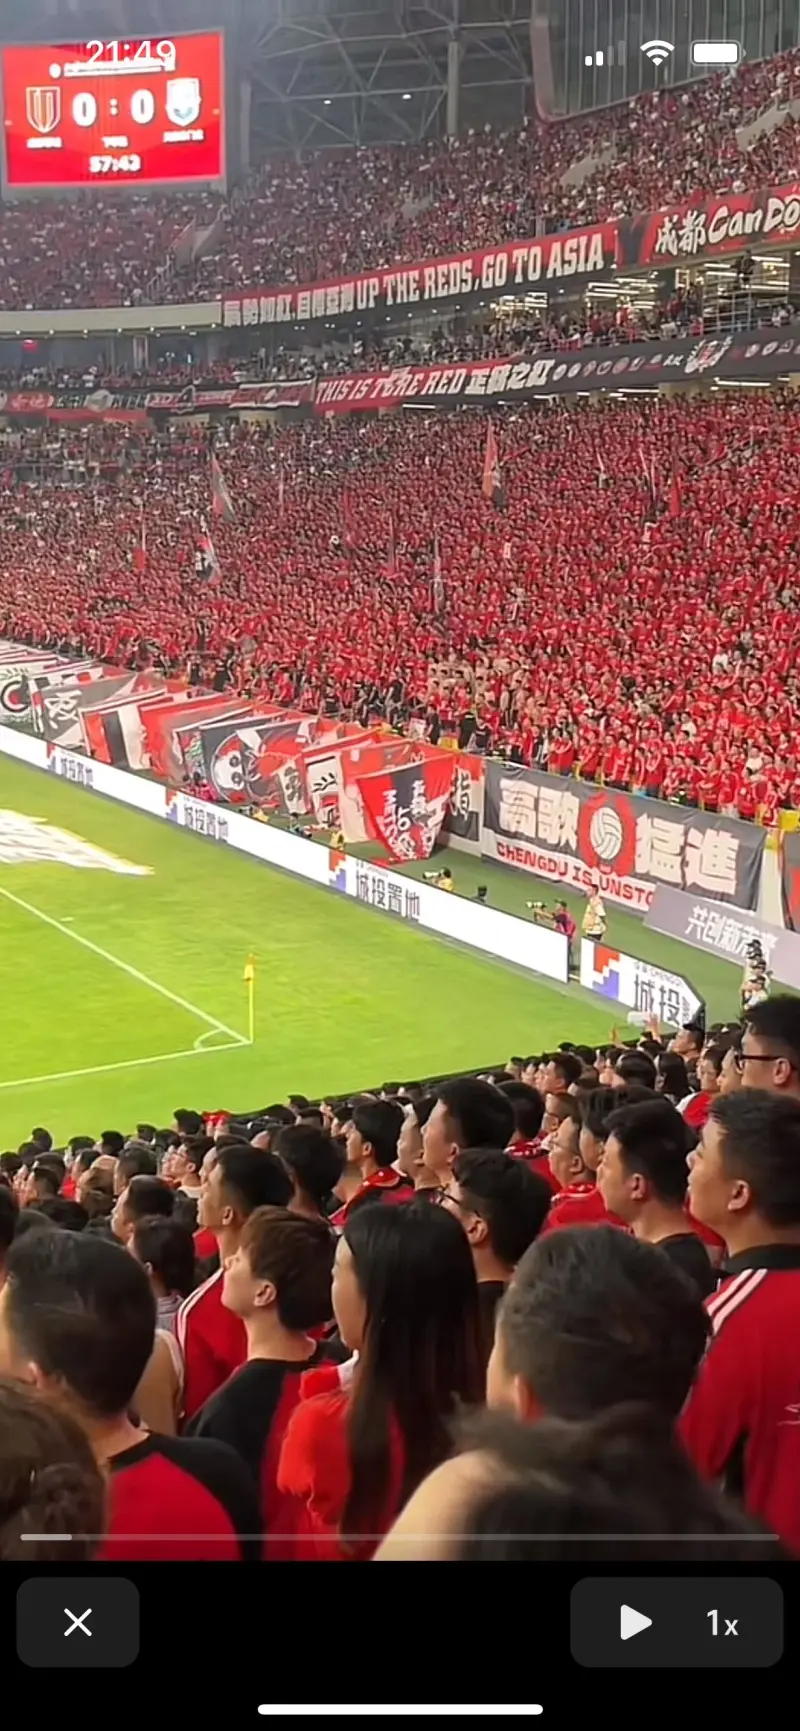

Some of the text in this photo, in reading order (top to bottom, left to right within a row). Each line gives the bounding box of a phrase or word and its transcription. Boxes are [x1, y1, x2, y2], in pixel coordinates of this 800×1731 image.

[72, 92, 97, 127] 0
[130, 88, 154, 124] 0
[356, 277, 380, 310] UP
[383, 267, 420, 306] THE
[512, 246, 541, 283] TO
[546, 233, 604, 279] ASIA
[315, 378, 352, 404] THIS
[350, 377, 373, 400] IS
[421, 368, 468, 395] RED
[496, 841, 569, 878] CHENGDU
[571, 865, 594, 888] IS
